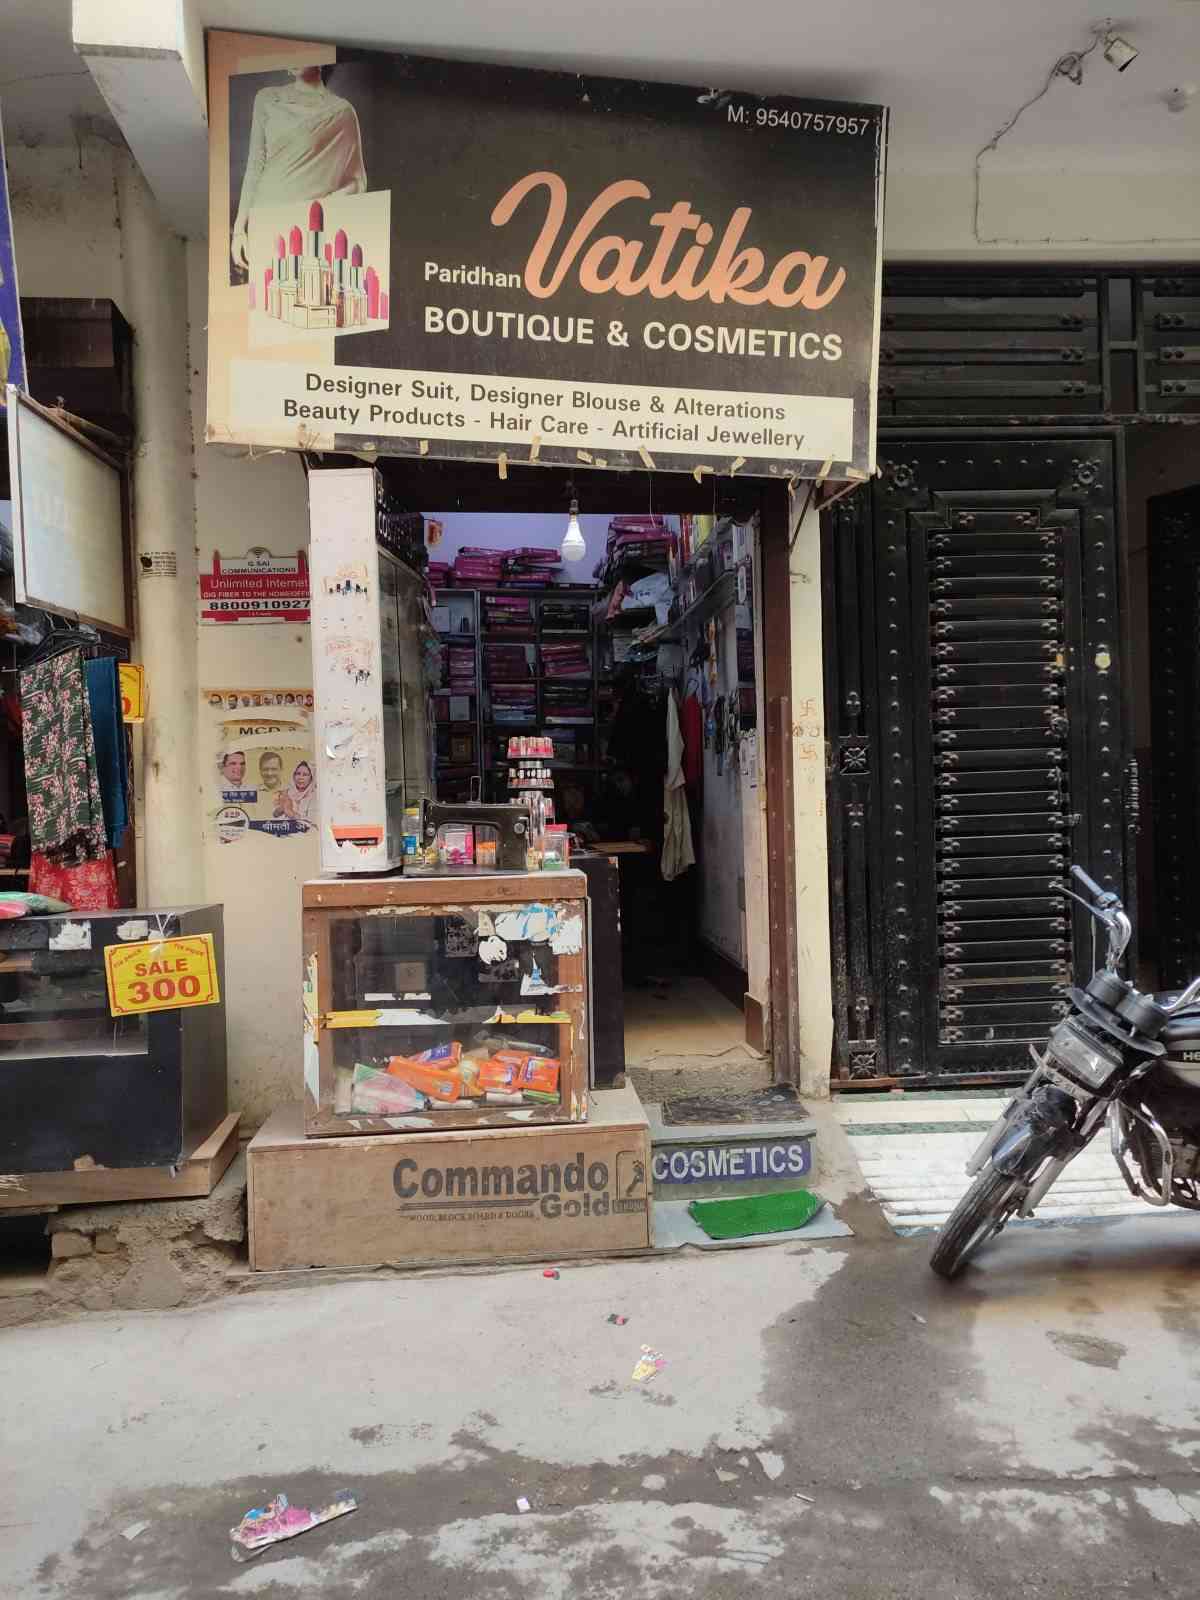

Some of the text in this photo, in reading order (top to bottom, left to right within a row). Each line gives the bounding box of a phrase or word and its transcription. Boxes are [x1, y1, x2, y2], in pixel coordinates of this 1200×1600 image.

[727, 104, 869, 136] M: 9540757957
[424, 171, 846, 310] Paridhan Vatika
[424, 306, 843, 361] BOUTIQUE & COSMETICS
[306, 373, 786, 420] Designer Suit, Designer Blouse & Alterations
[284, 400, 359, 424] Beauty
[370, 404, 465, 428] Products
[490, 412, 532, 431] Hair
[541, 415, 589, 435] Care
[612, 420, 699, 441] Artificial
[706, 425, 805, 450] Jewellery
[210, 578, 308, 589] Unlimited Internet
[209, 600, 310, 611] 8800910927
[135, 958, 188, 977] SALE
[128, 976, 200, 1004] 300
[393, 1153, 609, 1198] Commando
[652, 1145, 804, 1180] COSMETICS
[540, 1192, 610, 1219] Gold
